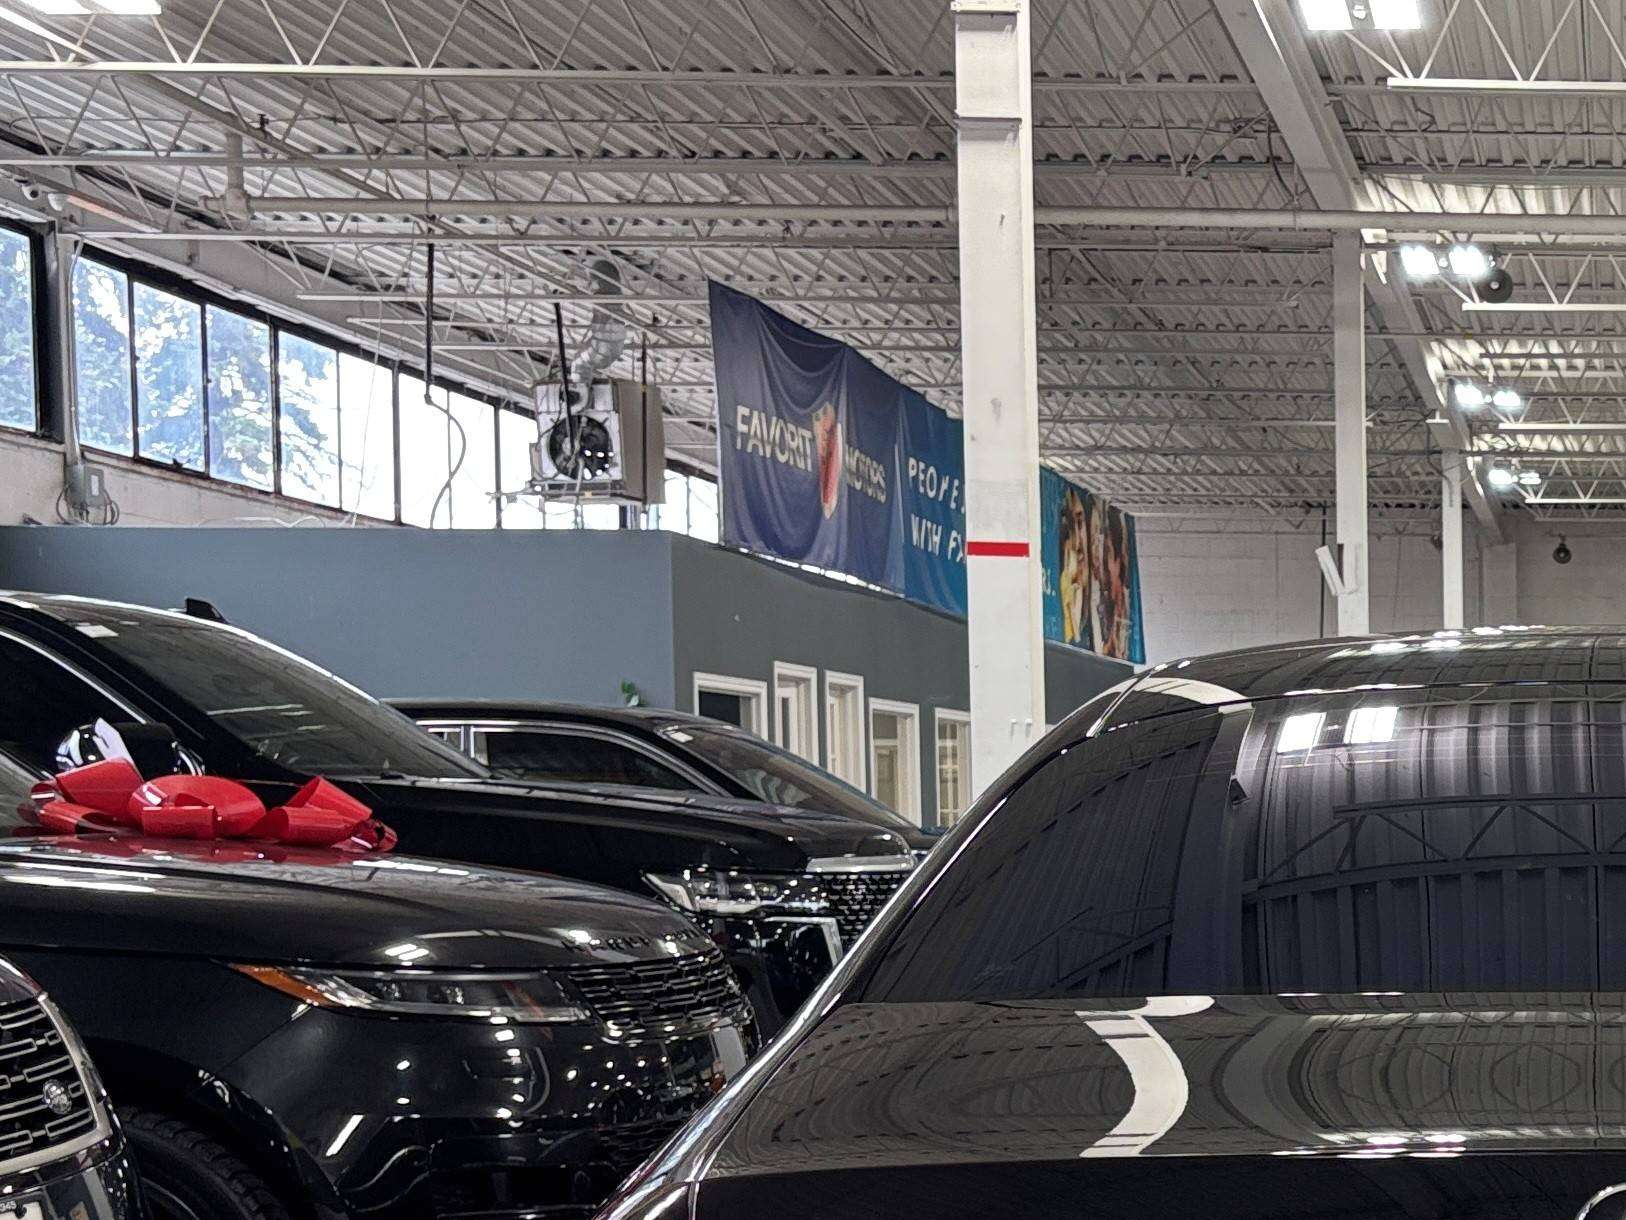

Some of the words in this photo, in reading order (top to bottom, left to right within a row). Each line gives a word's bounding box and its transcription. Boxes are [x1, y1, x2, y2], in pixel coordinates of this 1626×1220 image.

[736, 405, 813, 472] FAVORIT
[845, 444, 887, 504] MOTORS
[911, 513, 943, 557] WITH
